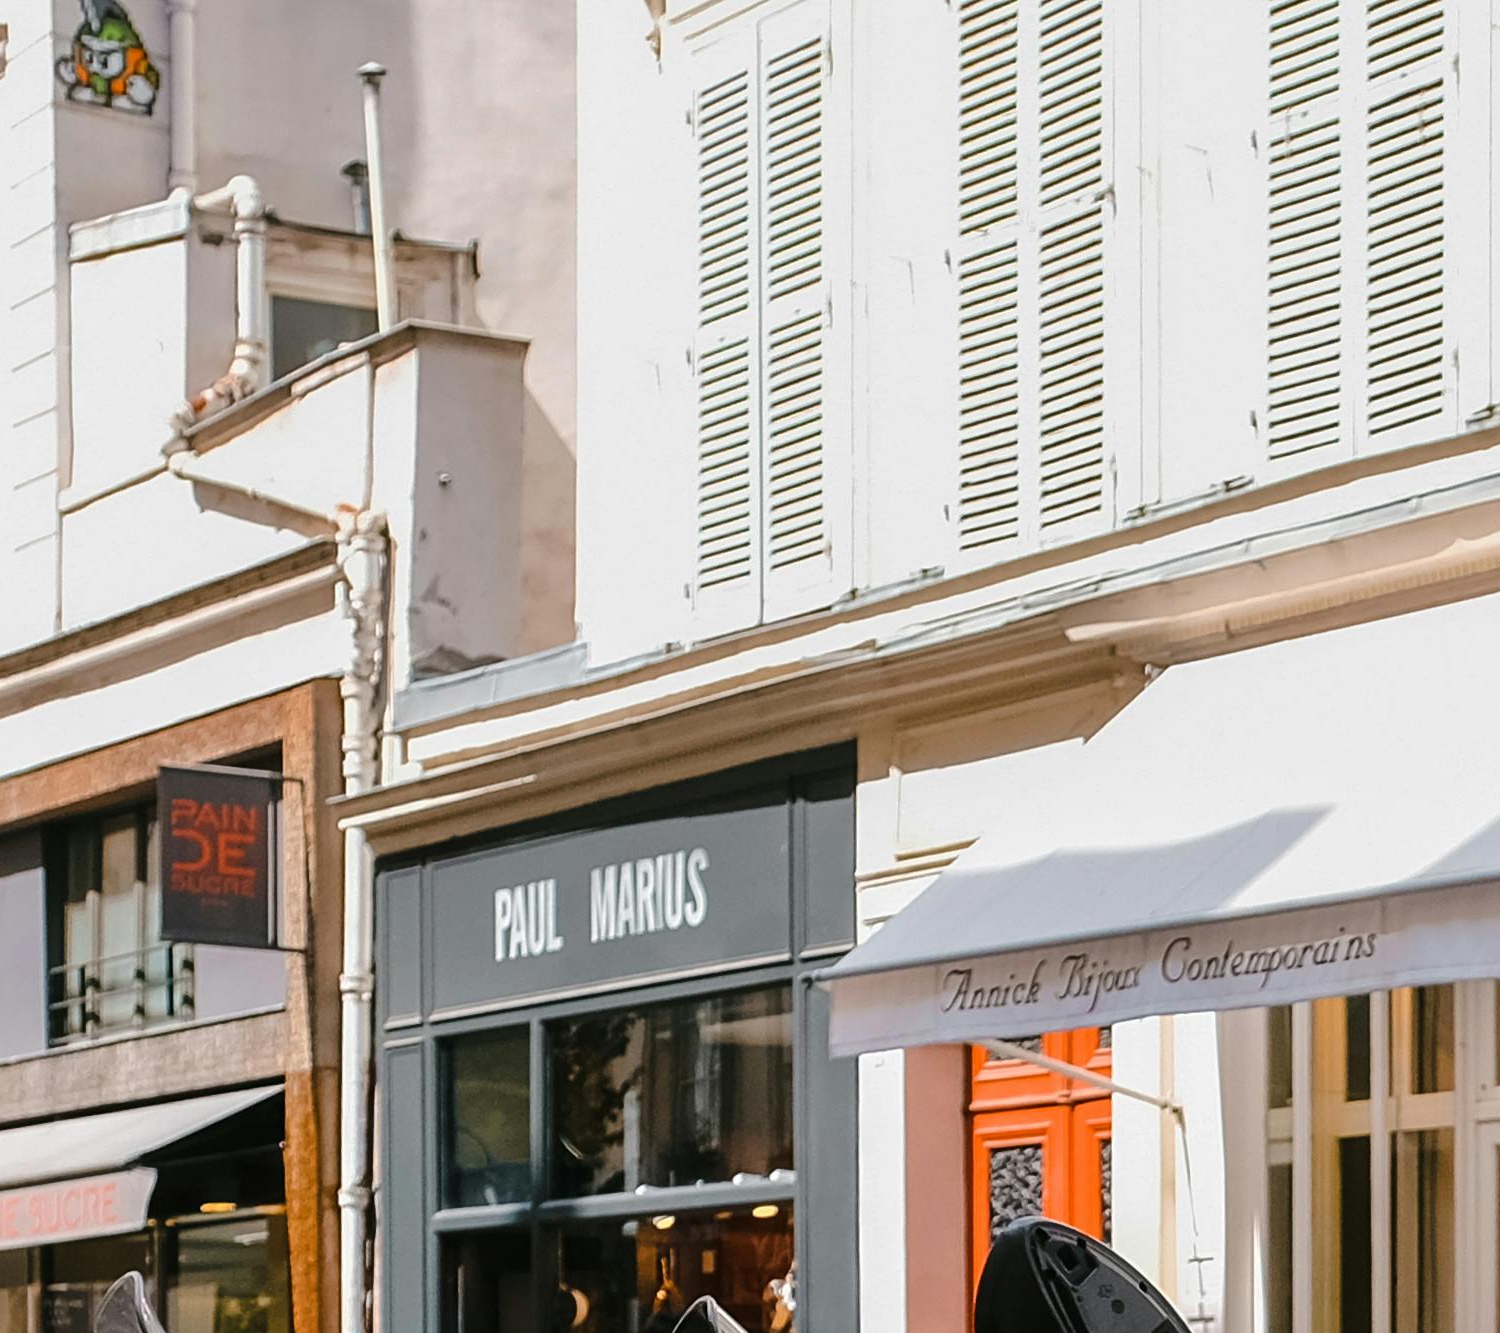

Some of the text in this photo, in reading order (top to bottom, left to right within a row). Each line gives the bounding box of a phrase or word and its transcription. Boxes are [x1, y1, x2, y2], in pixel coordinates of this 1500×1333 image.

[170, 798, 258, 832] PAIN
[171, 828, 257, 878] DE
[171, 872, 257, 897] SUCRE
[494, 846, 711, 962] PAUL MARIUS
[940, 926, 1378, 1014] Annick Bijoux Contemporains
[28, 1182, 118, 1234] SUCRE
